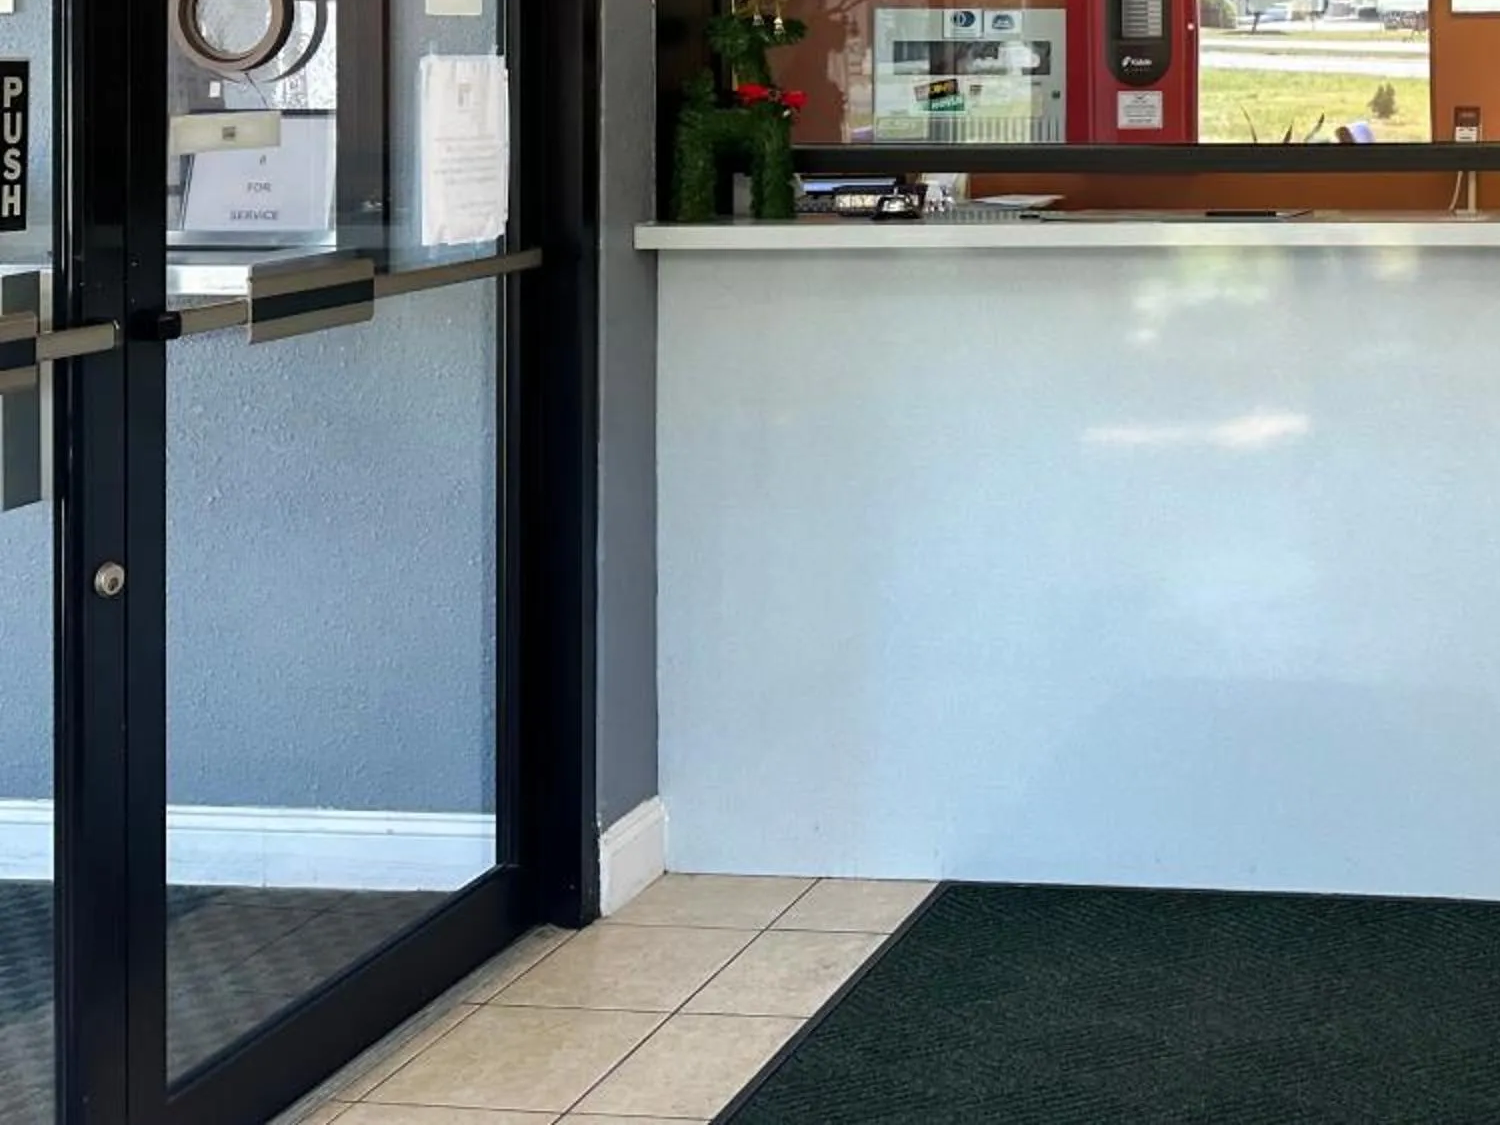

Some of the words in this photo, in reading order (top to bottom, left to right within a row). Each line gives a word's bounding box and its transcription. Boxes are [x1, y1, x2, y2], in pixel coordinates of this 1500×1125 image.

[2, 75, 24, 217] PUSH
[247, 182, 272, 193] FOR
[230, 210, 280, 221] SERVICE
